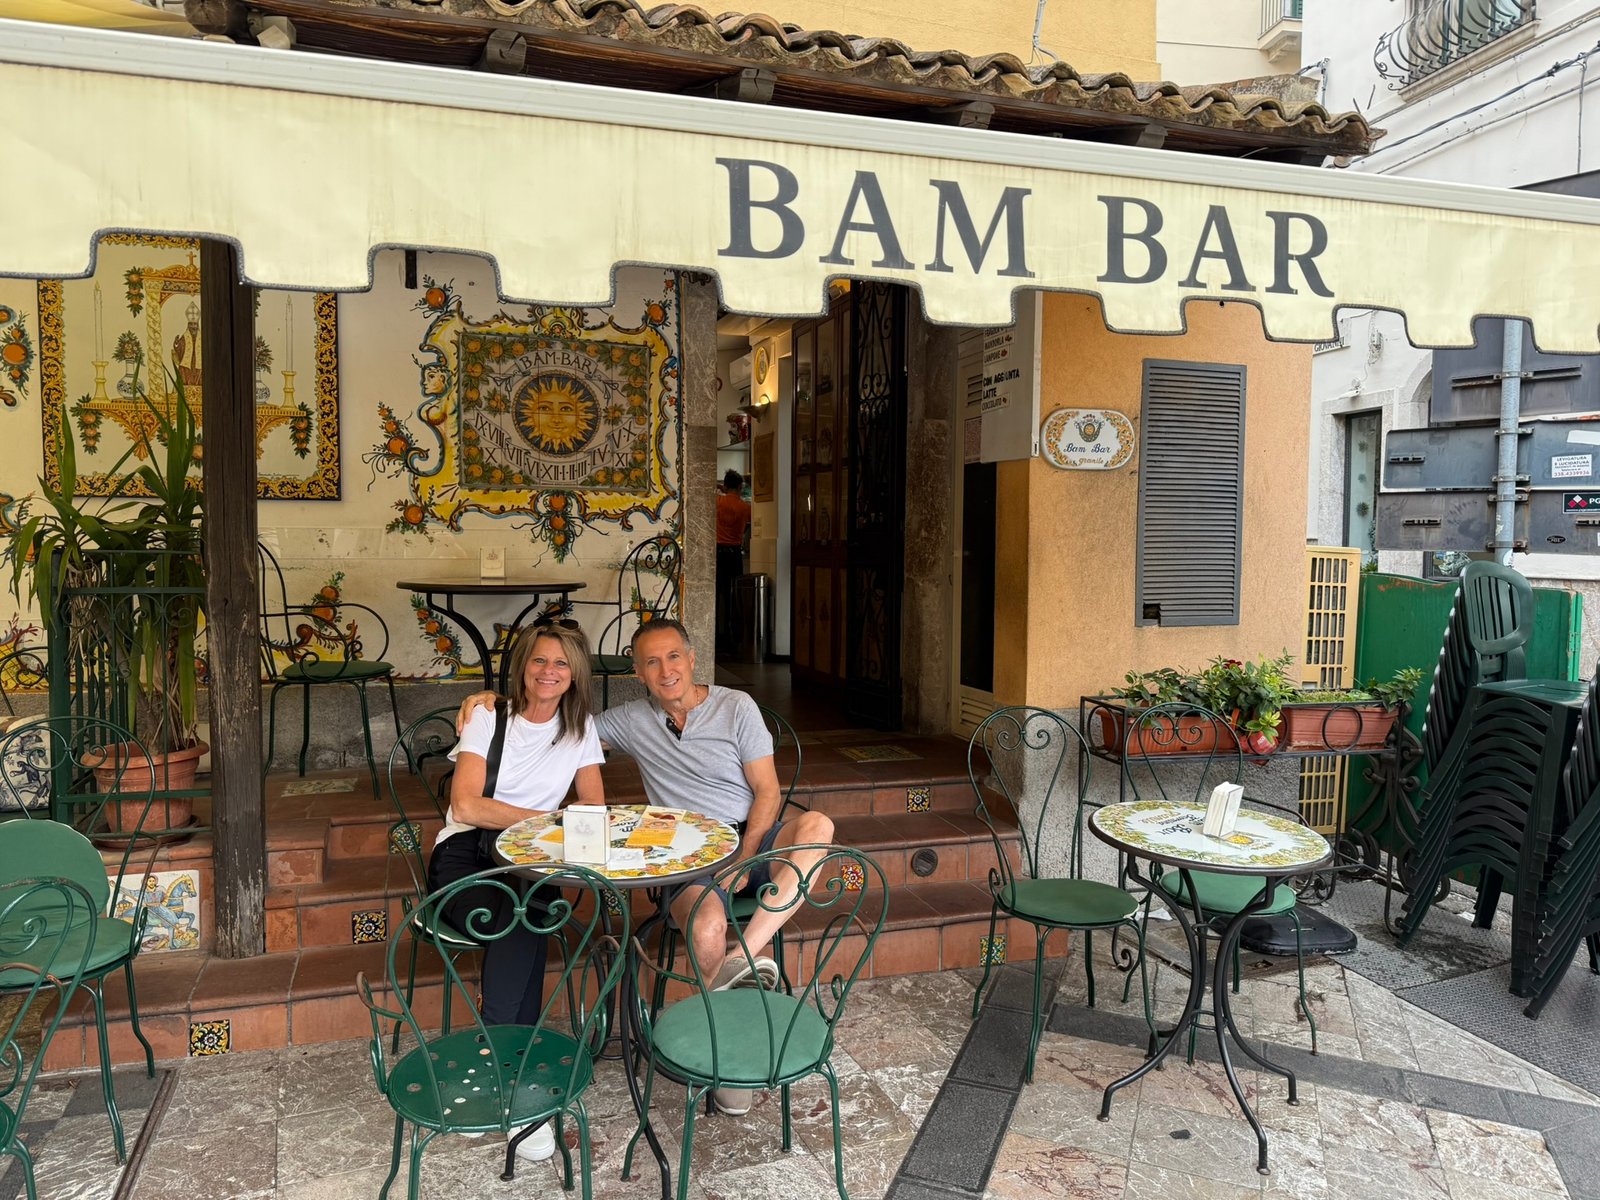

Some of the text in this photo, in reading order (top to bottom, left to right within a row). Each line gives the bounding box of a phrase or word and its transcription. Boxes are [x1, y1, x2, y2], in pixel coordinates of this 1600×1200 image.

[715, 158, 1335, 298] BAM BAR
[983, 376, 993, 387] CON
[983, 388, 997, 400] LATTE
[1063, 442, 1112, 454] Bam Bar
